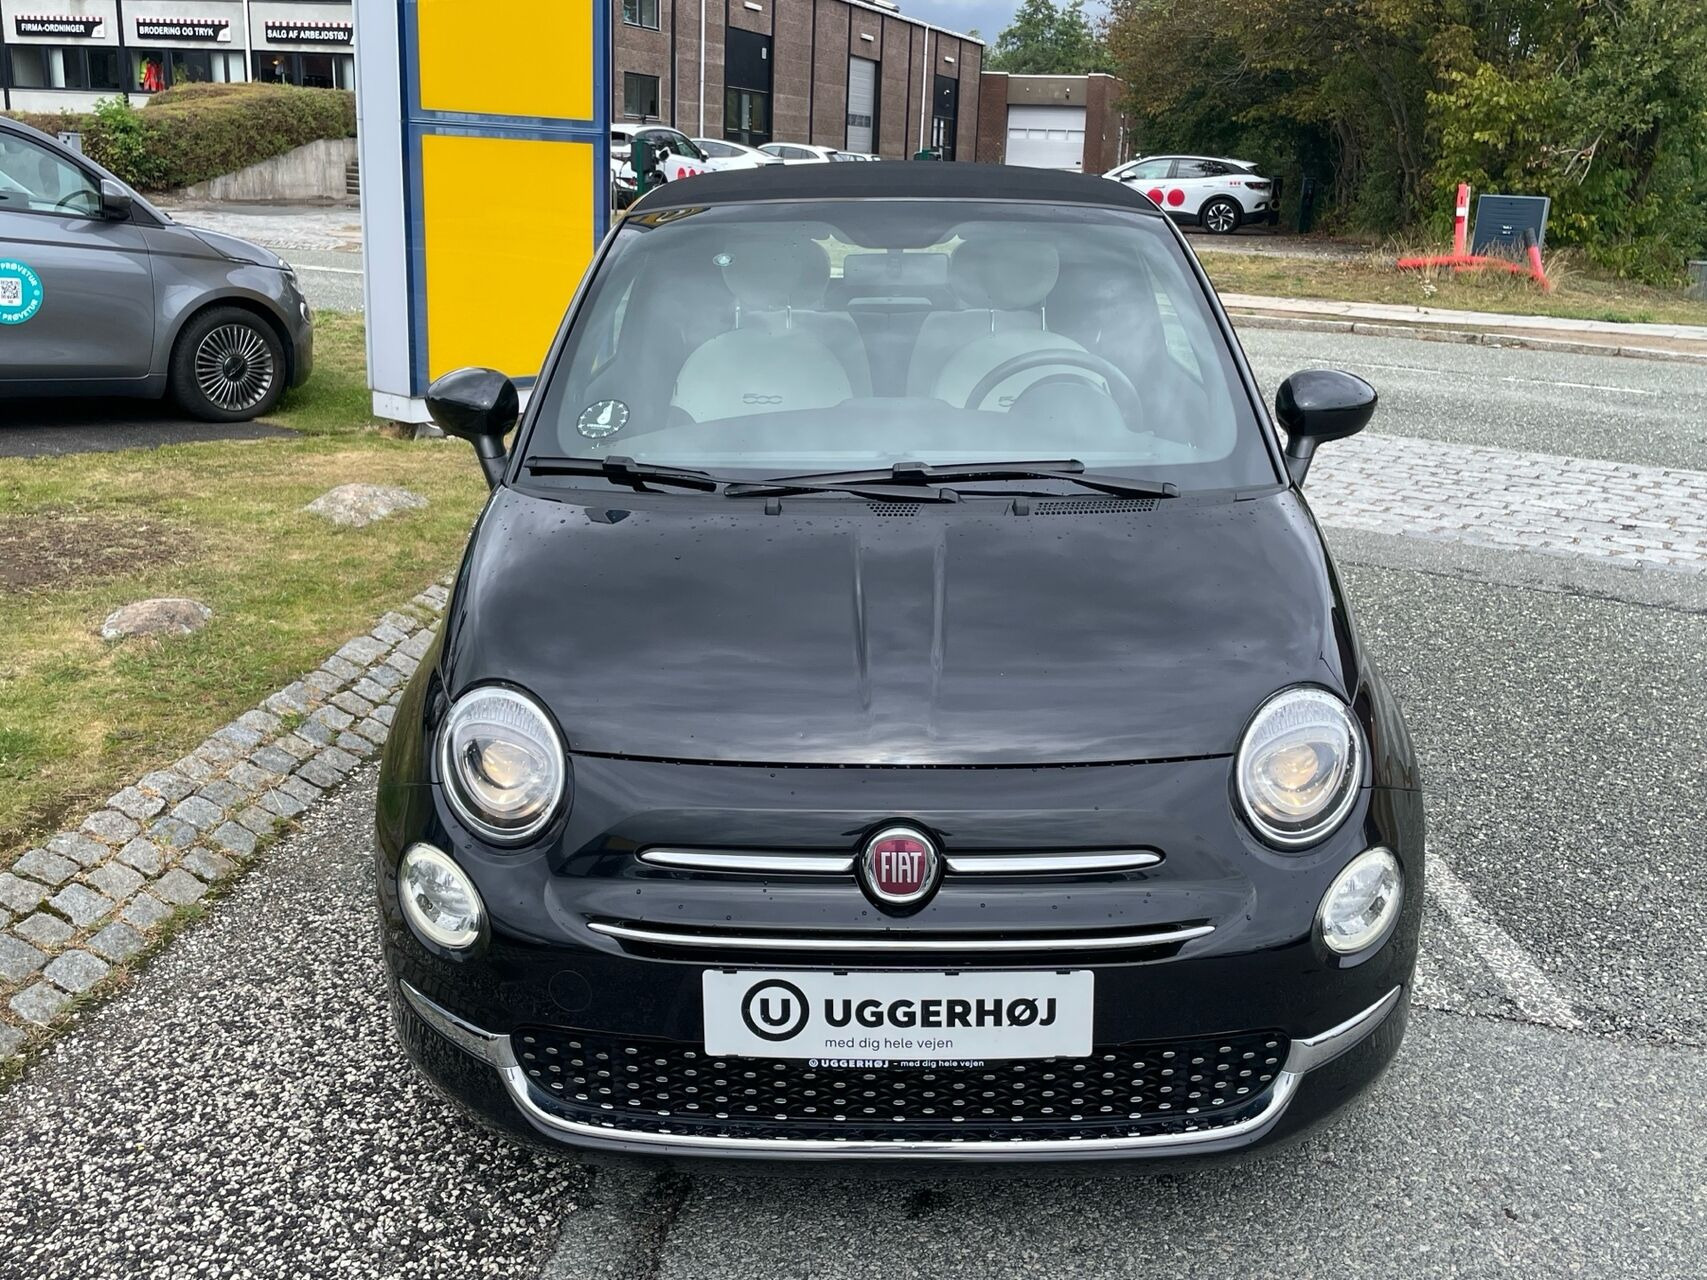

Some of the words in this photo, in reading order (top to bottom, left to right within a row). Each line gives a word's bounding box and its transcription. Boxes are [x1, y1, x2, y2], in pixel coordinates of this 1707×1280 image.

[21, 23, 85, 33] FIRMA-ORDNINGER
[139, 26, 181, 36] BRODERING
[181, 27, 193, 36] OG
[194, 27, 214, 36] TRYK
[267, 29, 287, 38] SALG
[288, 30, 299, 39] AF
[299, 30, 348, 40] ARBEJDSTØJ
[2, 299, 38, 322] PRØVETUR
[880, 851, 922, 883] FIAT
[824, 997, 1057, 1028] UGGERHØJ
[825, 1037, 855, 1048] med
[858, 1037, 880, 1052] dig
[884, 1037, 913, 1049] hele
[916, 1037, 953, 1052] vejen
[820, 1059, 889, 1068] UGGERHØJ
[921, 1059, 936, 1069] dig
[959, 1059, 985, 1069] vejen
